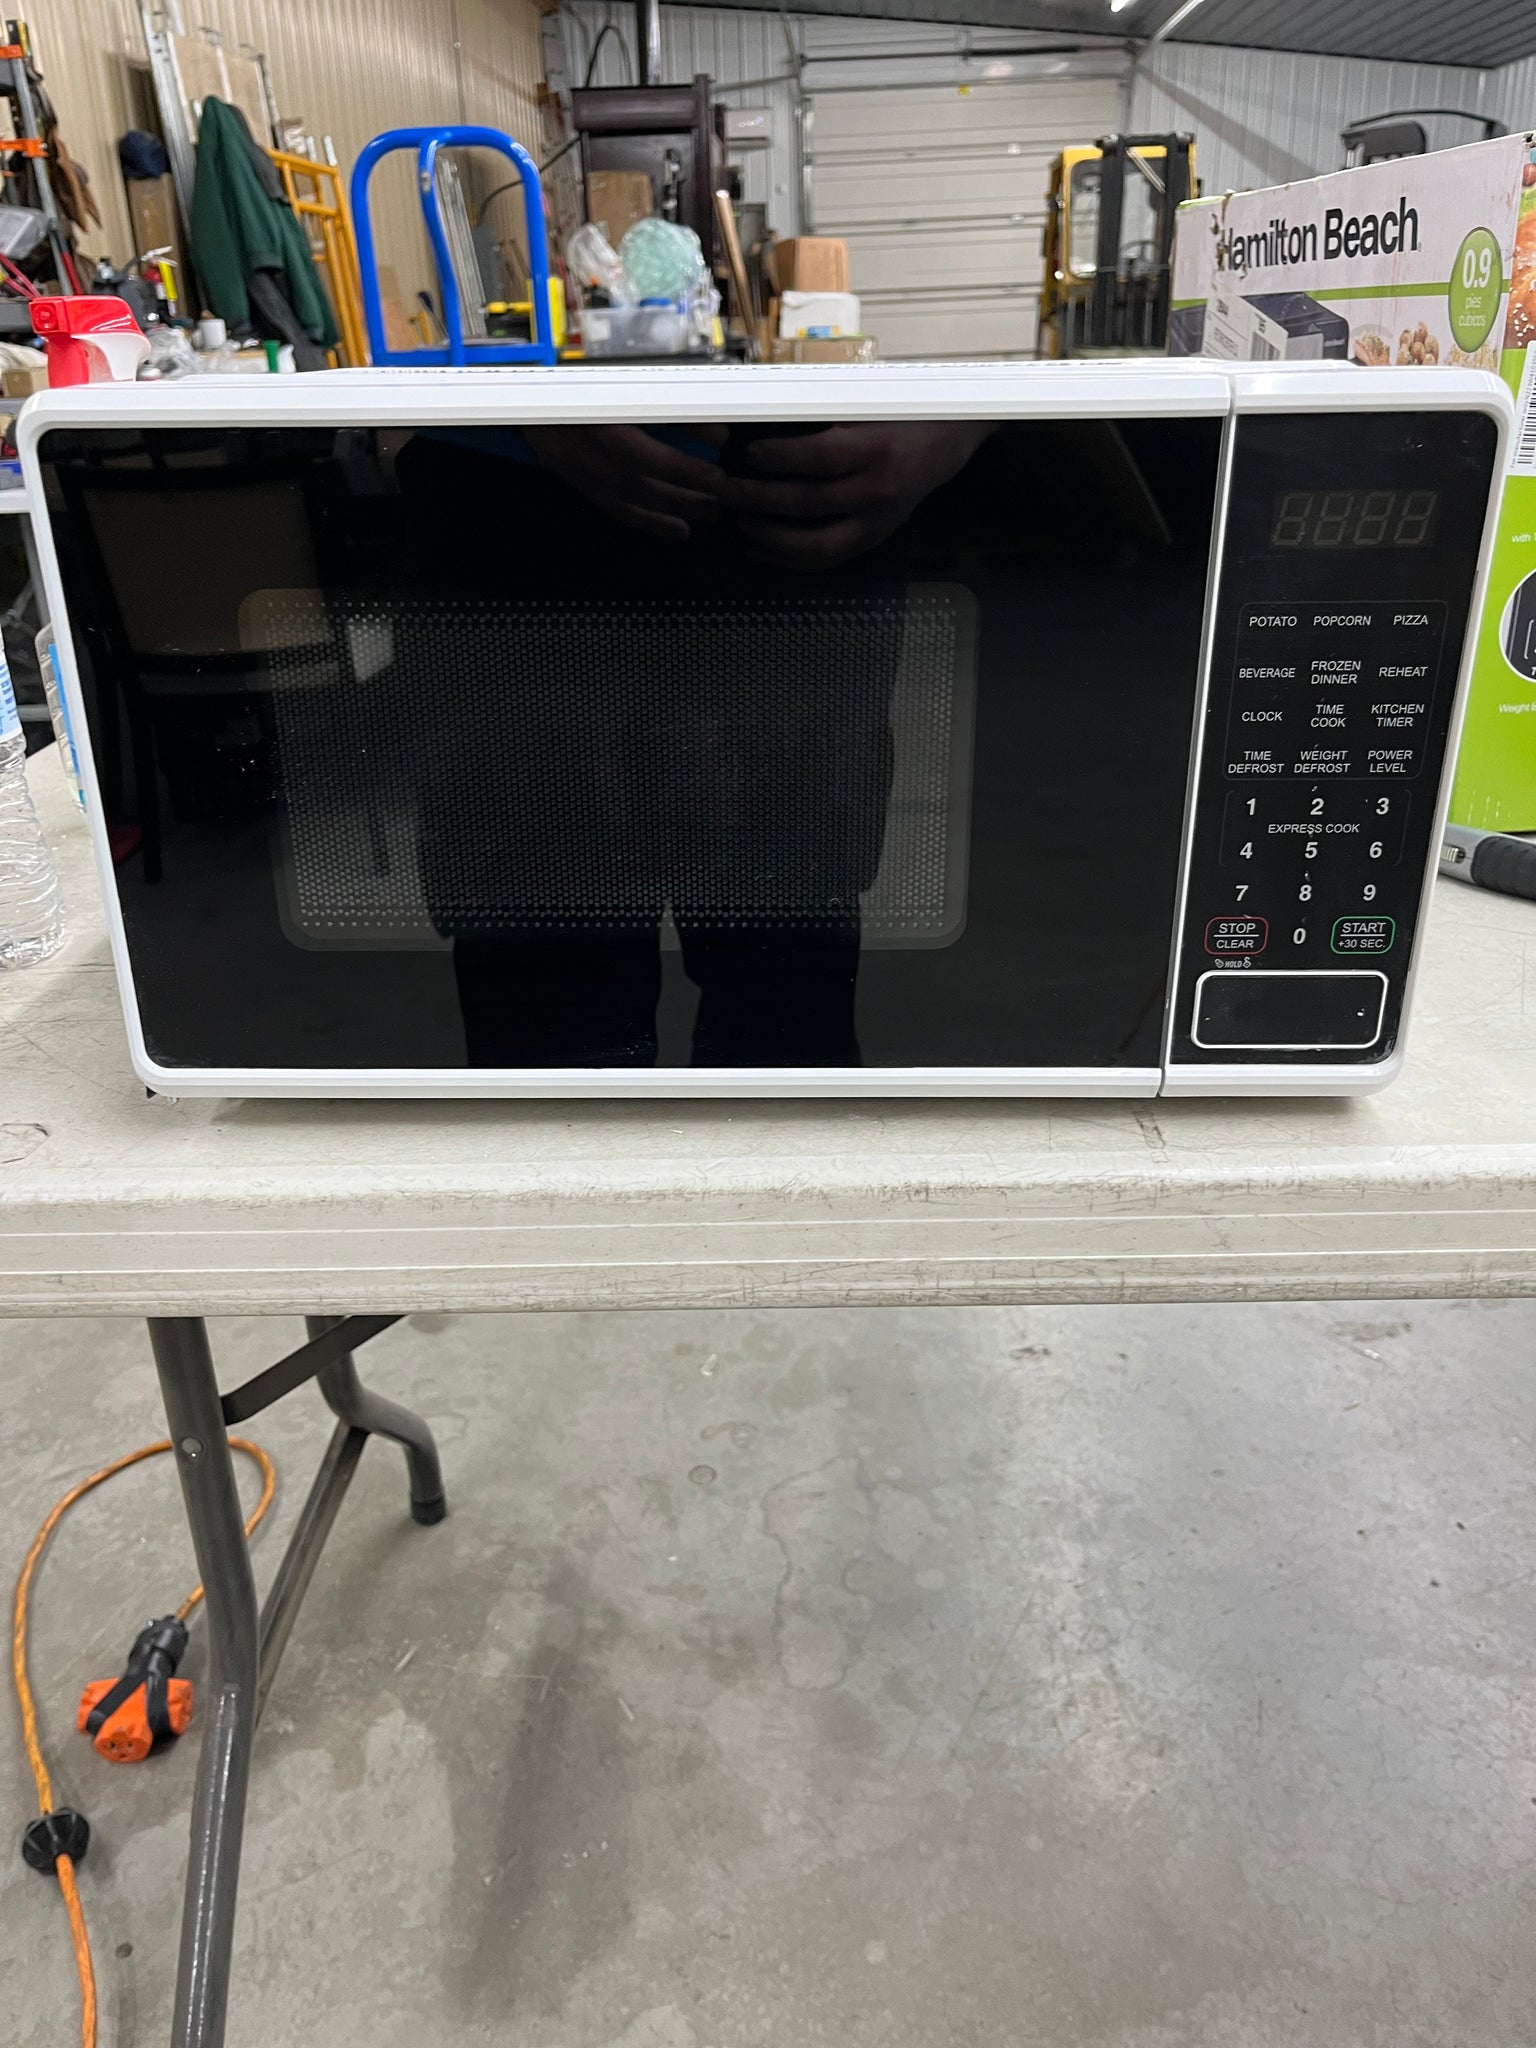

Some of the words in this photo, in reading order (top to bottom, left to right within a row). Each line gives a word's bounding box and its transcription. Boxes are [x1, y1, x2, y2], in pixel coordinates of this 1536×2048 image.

[1323, 196, 1419, 261] Beach
[1462, 247, 1492, 289] 0.9
[1249, 615, 1298, 627] POTATO
[1313, 615, 1372, 627] POPCORN
[1392, 614, 1429, 626] PIZZA
[1310, 660, 1362, 671] FROZEN
[1378, 666, 1429, 677] REHEAT
[1238, 667, 1296, 679] BEVERAGE
[1310, 673, 1358, 685] DINNER
[1315, 704, 1345, 715] TIME
[1370, 703, 1425, 715] KITCHEN
[1241, 711, 1283, 722] CLOCK
[1310, 717, 1347, 728] COOK
[1376, 716, 1414, 727] TIMER
[1243, 750, 1272, 761] TIME
[1300, 750, 1349, 761] WEIGHT
[1367, 749, 1413, 761] POWER
[1227, 763, 1285, 774] DEFROST
[1293, 763, 1351, 774] DEFROST
[1369, 762, 1407, 773] LEVEL
[1246, 798, 1256, 816] 1
[1310, 797, 1325, 816] 2
[1375, 797, 1390, 815] 3
[1267, 823, 1323, 835] EXPRESS
[1325, 823, 1361, 834] COOK
[1239, 841, 1253, 859] 4
[1304, 841, 1319, 859] 5
[1369, 841, 1383, 859] 6
[1235, 884, 1249, 902] 7
[1298, 884, 1312, 902] 8
[1362, 884, 1377, 902] 9
[1218, 922, 1256, 934] STOP
[1341, 921, 1387, 934] START
[1293, 927, 1306, 945] 0
[1216, 939, 1254, 949] CLEAR
[1338, 939, 1358, 949] +30
[1359, 938, 1386, 948] SEC.
[1224, 960, 1243, 969] HOLD
